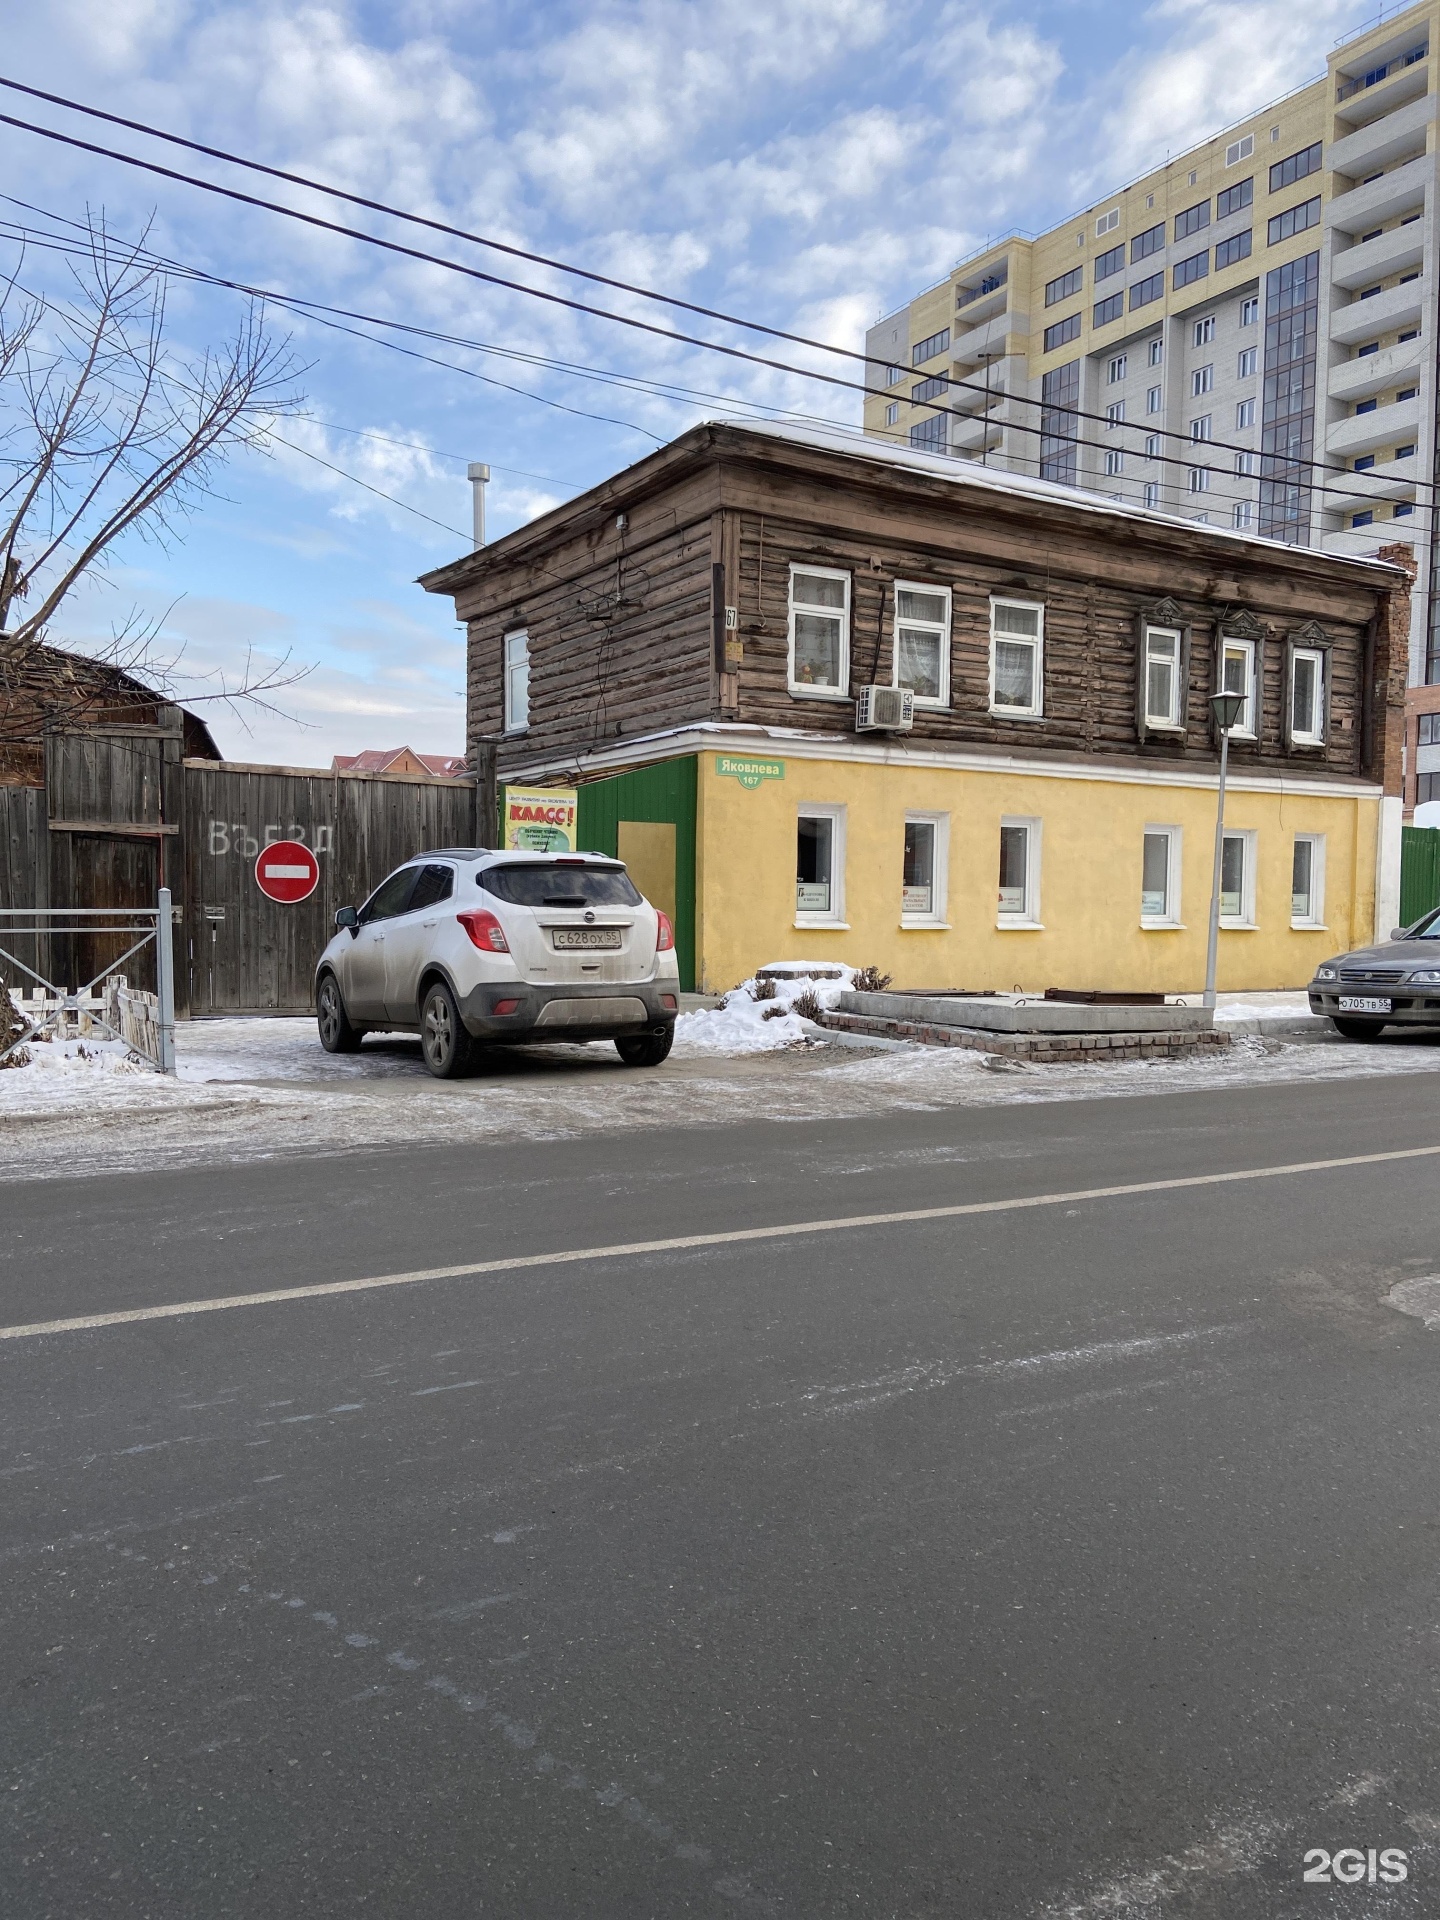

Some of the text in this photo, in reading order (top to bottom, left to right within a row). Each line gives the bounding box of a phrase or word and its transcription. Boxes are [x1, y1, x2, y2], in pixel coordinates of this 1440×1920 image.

[725, 609, 736, 627] 67
[721, 759, 780, 775] Яковлева
[743, 776, 759, 785] 167
[558, 931, 617, 944] С628ОХ 55
[1378, 999, 1388, 1007] 55
